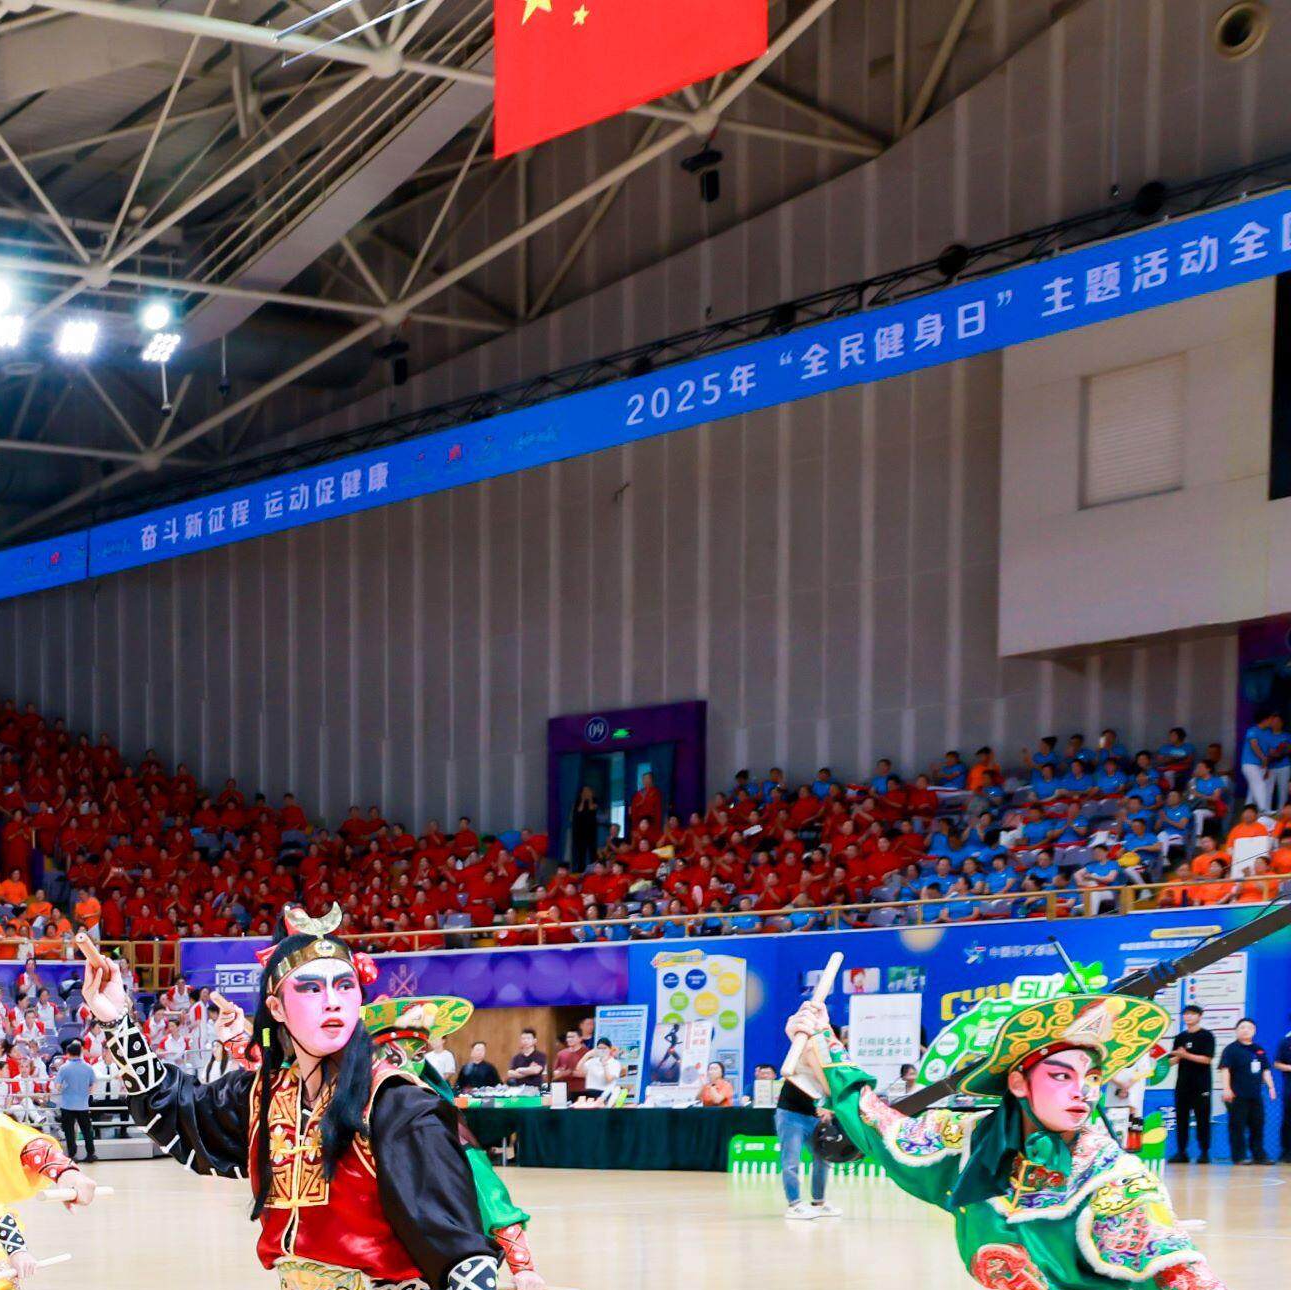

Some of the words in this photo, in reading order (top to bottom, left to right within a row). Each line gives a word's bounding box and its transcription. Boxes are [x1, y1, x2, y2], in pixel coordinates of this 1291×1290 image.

[141, 499, 250, 551] 奋斗新征程
[264, 462, 390, 519] 运动促健康
